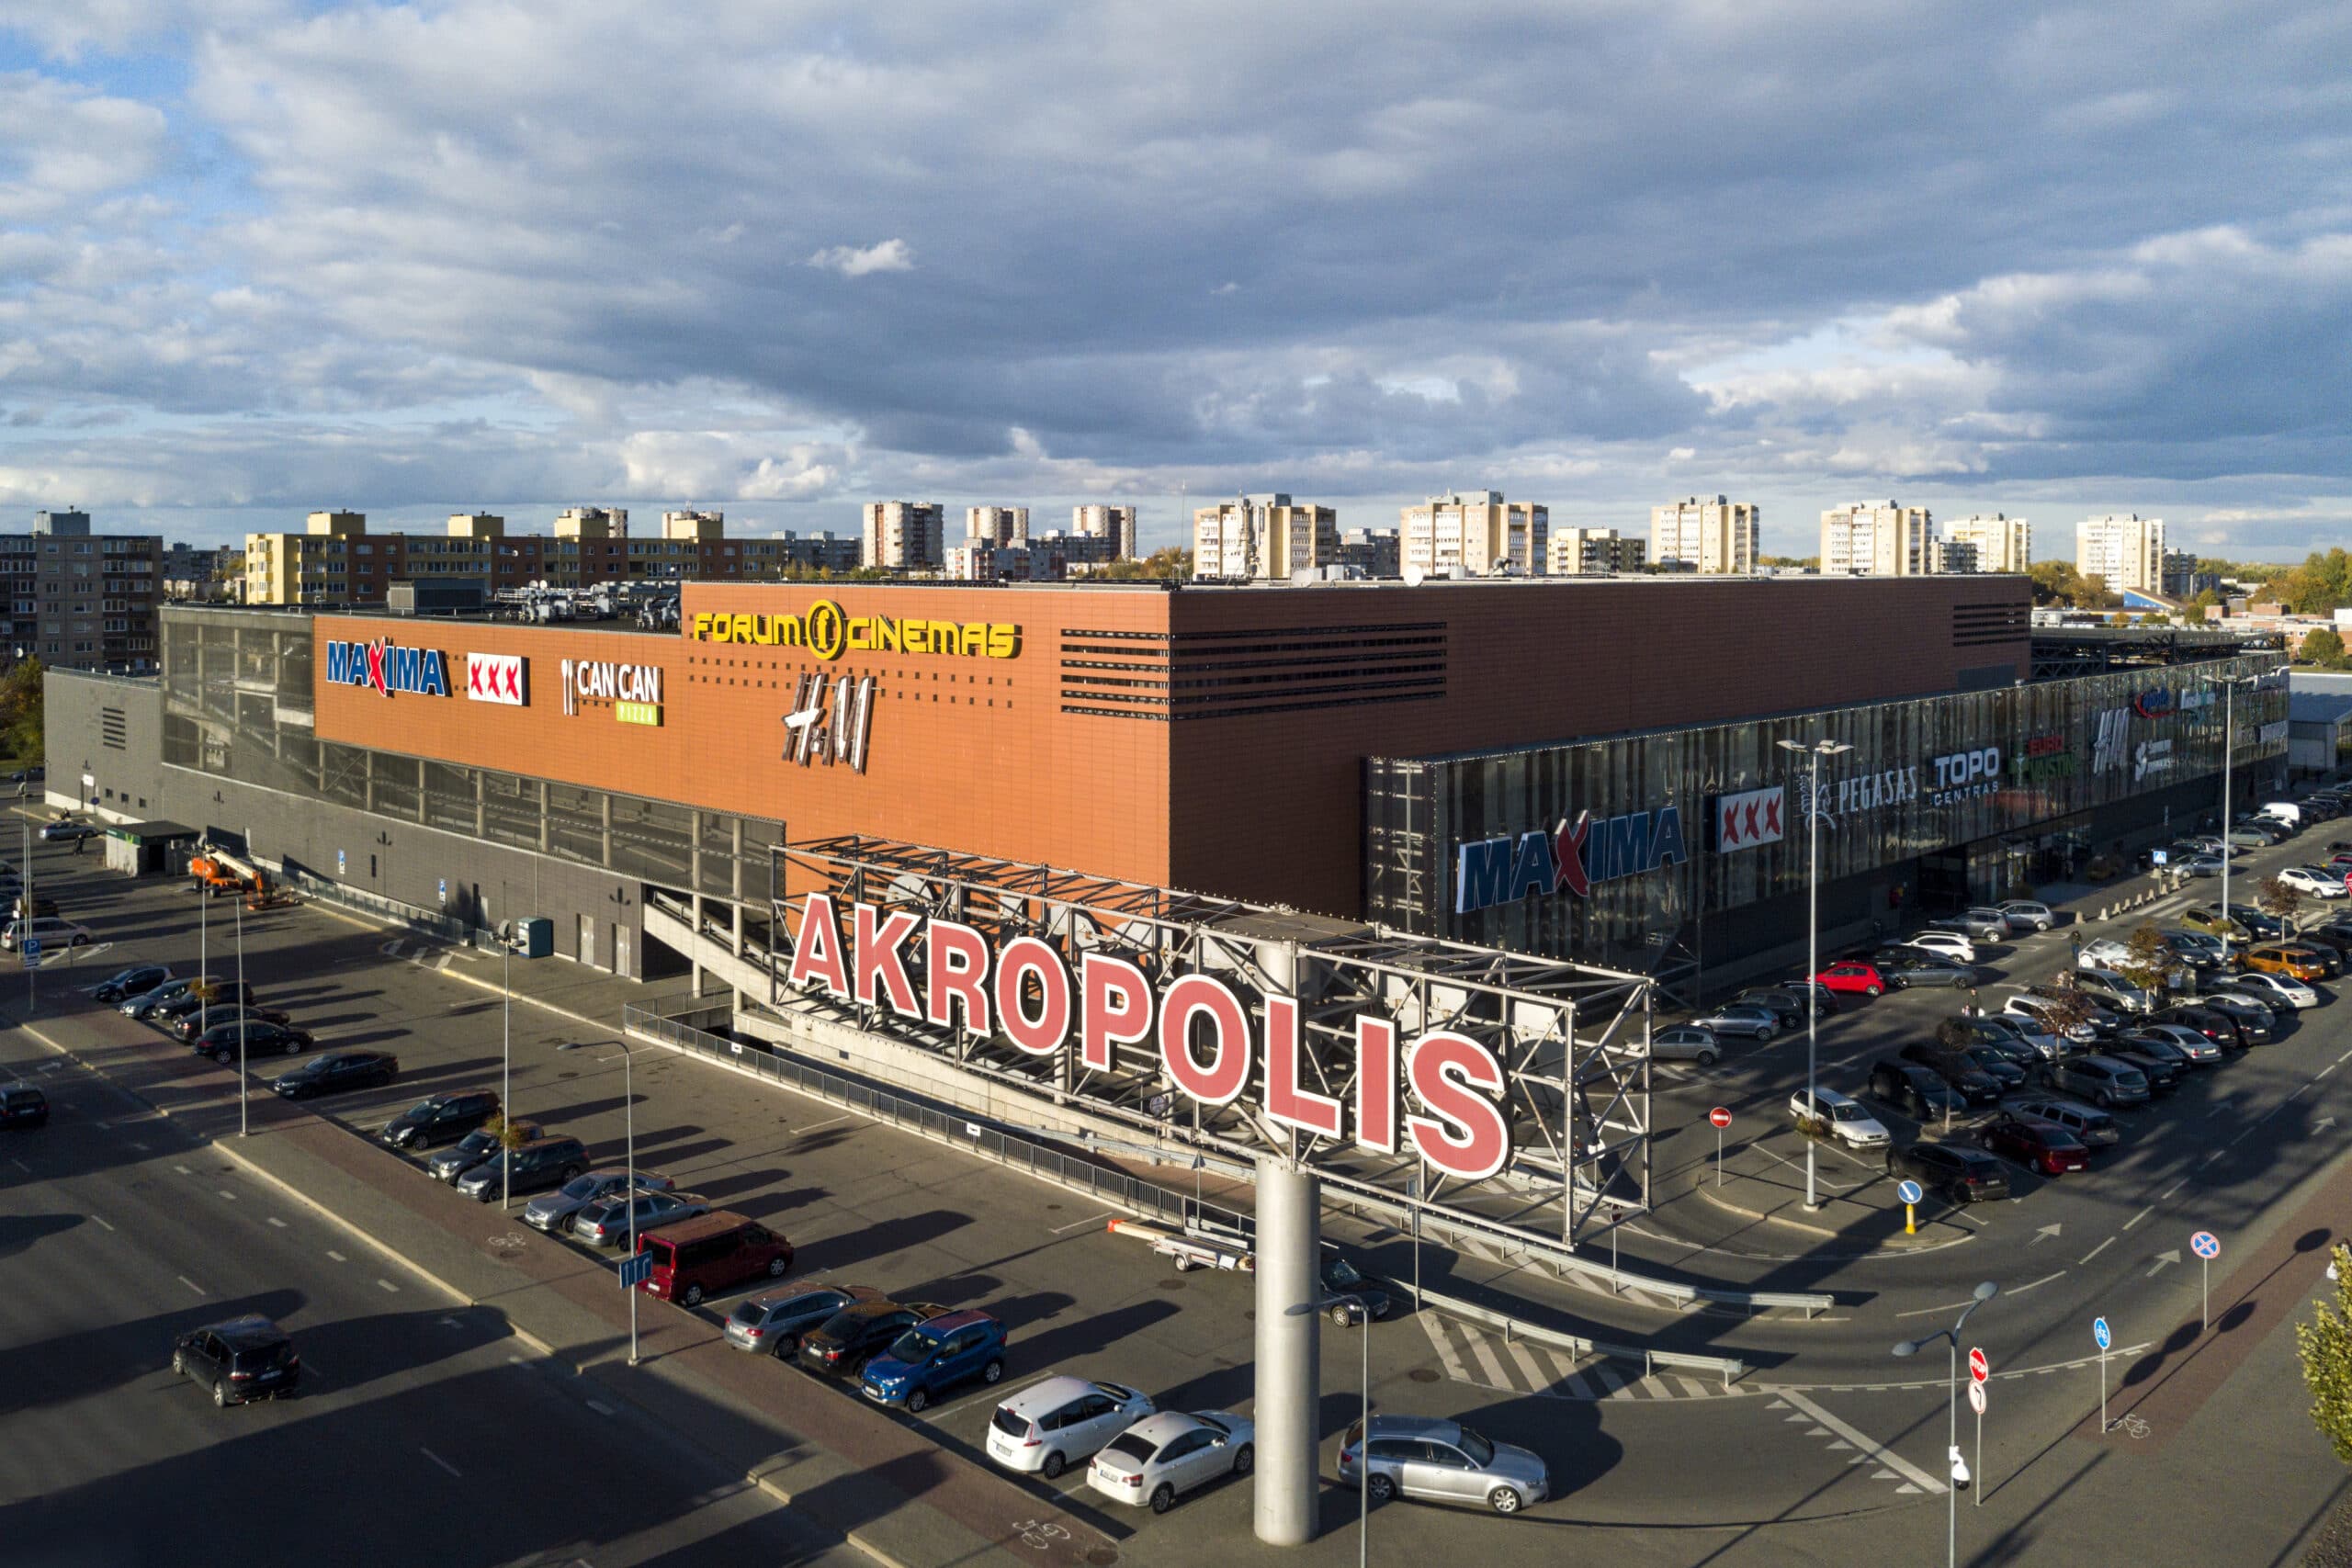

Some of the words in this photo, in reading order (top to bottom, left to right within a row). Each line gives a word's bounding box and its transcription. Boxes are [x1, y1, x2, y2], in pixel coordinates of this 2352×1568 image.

[694, 613, 800, 646] FORUM
[846, 615, 1016, 659] CINEMAS
[326, 636, 446, 697] MAXIMA
[577, 660, 615, 698] CAN
[618, 664, 659, 703] CAN
[619, 705, 652, 722] PIZZA
[782, 671, 873, 774] H&M
[1838, 765, 1917, 815] PEGASAS
[1935, 747, 2000, 788] TOPO
[1934, 781, 1999, 807] CENTRAS
[1456, 807, 1688, 914] MAXIMA
[786, 891, 1512, 1180] AKROPOLIS
[1970, 1357, 1986, 1374] STOP
